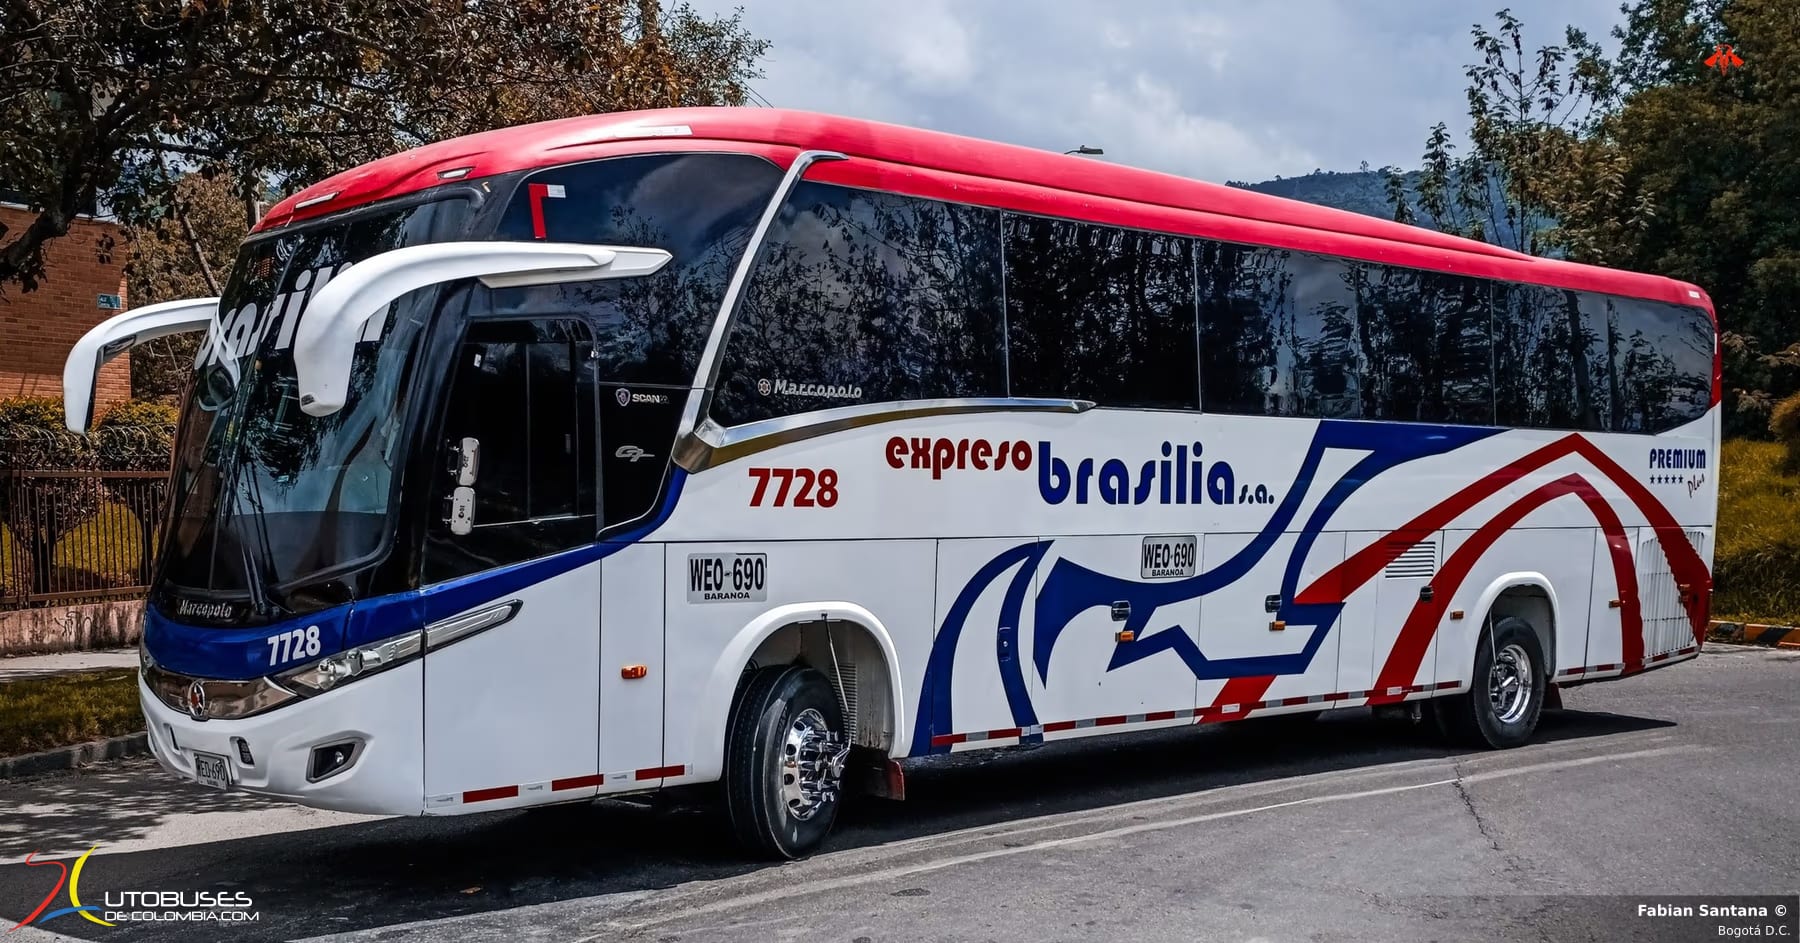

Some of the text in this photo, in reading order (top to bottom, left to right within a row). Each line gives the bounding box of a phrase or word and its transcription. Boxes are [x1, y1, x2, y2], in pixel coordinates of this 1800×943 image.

[632, 393, 670, 404] SCAN
[774, 379, 862, 399] Marcopolo
[1649, 448, 1706, 469] PREMIUM
[885, 436, 1033, 480] expreso
[1038, 441, 1235, 506] brasilia
[748, 468, 839, 508] 7728
[704, 592, 750, 600] BARANOA
[179, 599, 232, 619] Marcopolo
[267, 625, 322, 667] 7728
